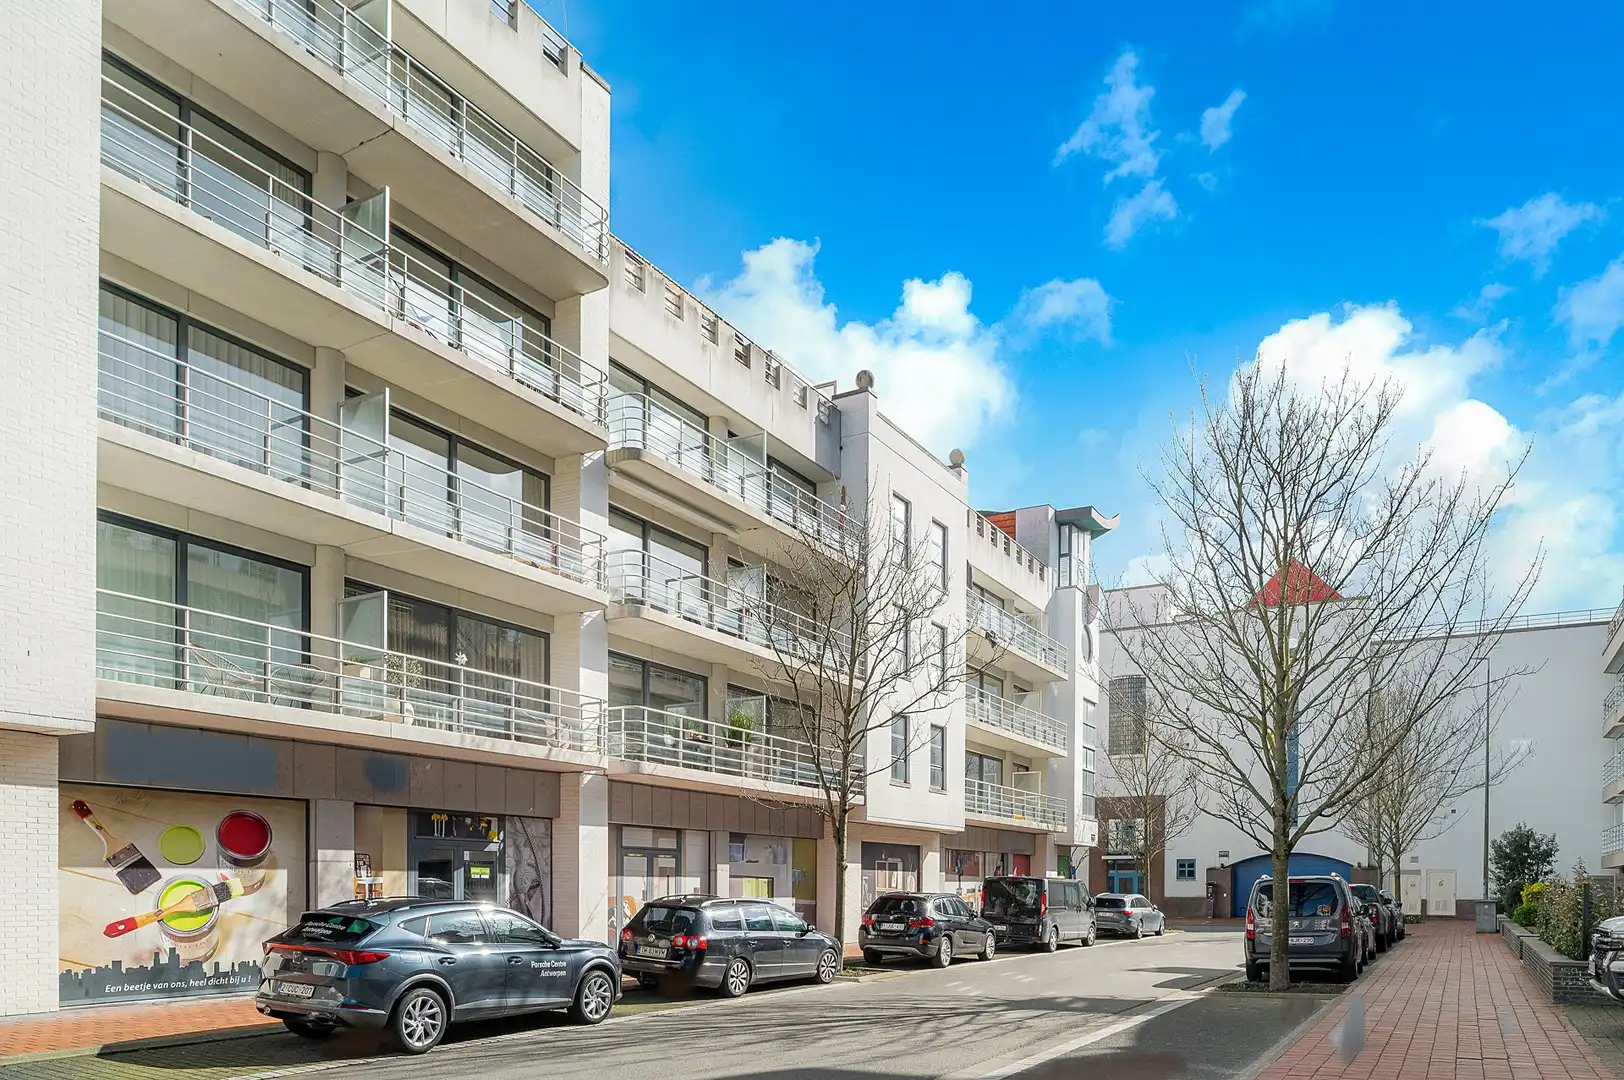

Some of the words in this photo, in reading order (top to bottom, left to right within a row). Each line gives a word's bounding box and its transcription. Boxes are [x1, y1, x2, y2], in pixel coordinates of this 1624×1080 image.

[531, 960, 551, 968] Porsche
[551, 960, 567, 968] Centre
[540, 970, 567, 978] Antwerpen
[105, 984, 122, 993] Een
[124, 982, 151, 992] beetje
[152, 982, 169, 990] van
[189, 979, 207, 987] heel
[208, 976, 228, 985] dicht
[229, 975, 240, 985] bij
